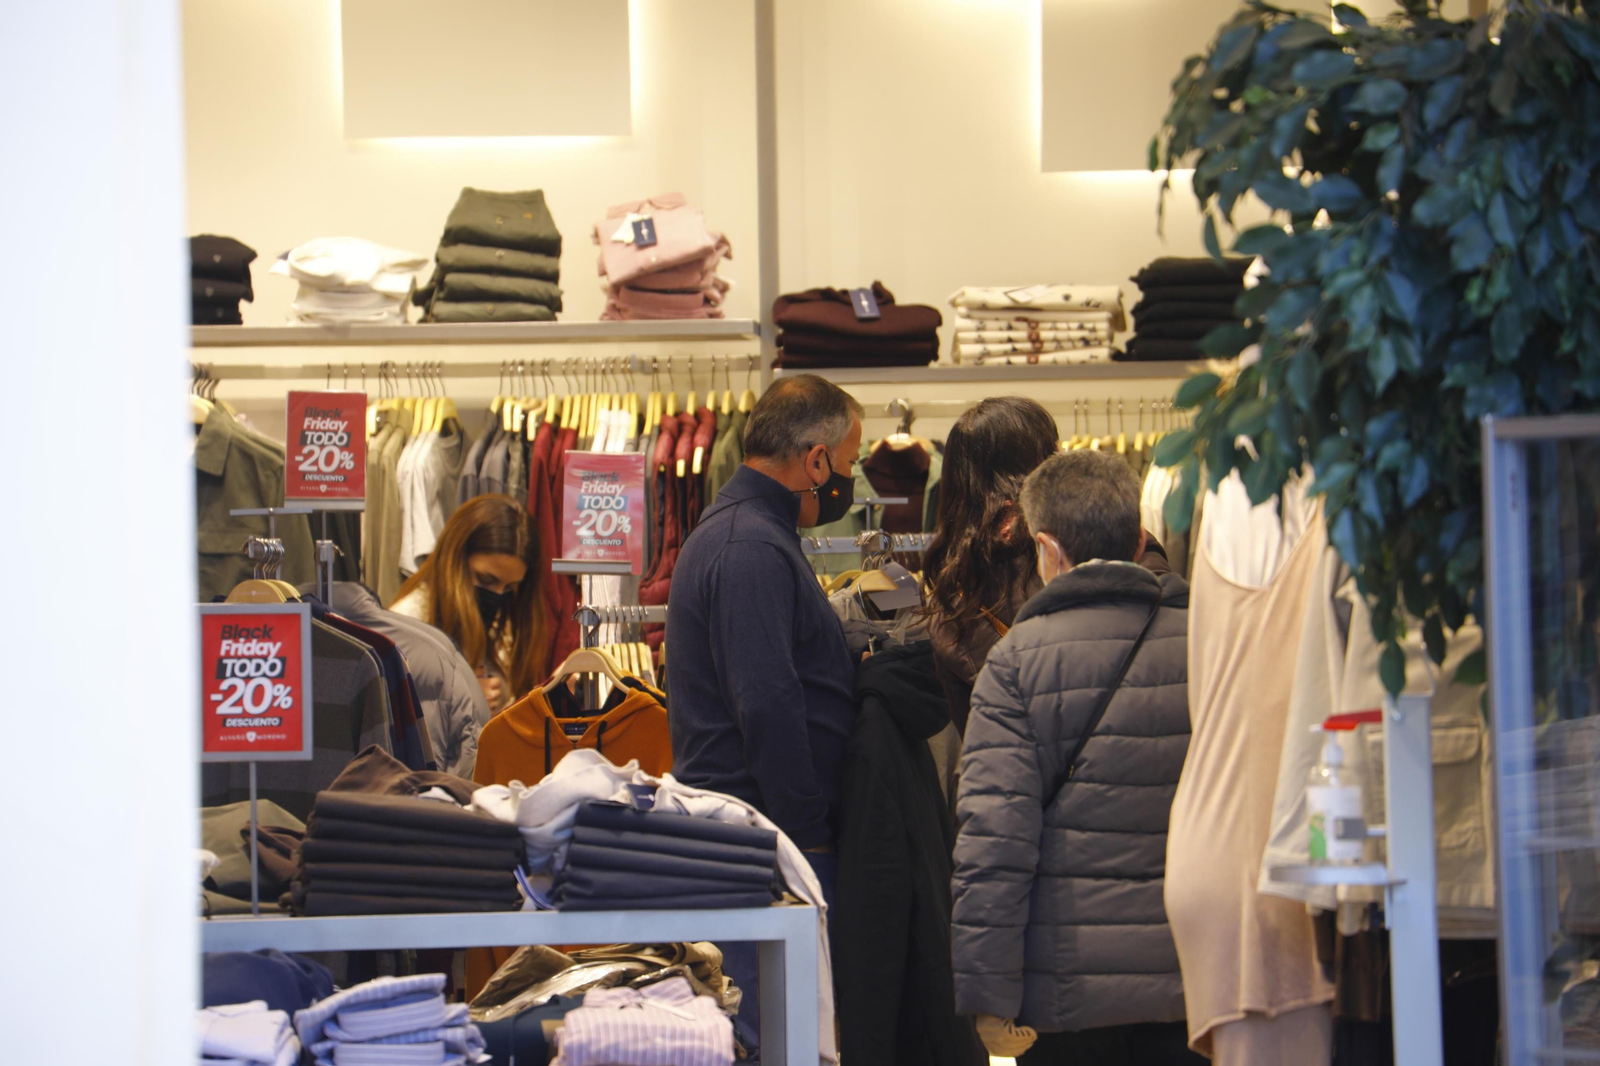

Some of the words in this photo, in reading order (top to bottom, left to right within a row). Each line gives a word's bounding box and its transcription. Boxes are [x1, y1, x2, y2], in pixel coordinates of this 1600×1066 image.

[304, 407, 342, 418] Black
[303, 417, 348, 433] Friday
[305, 431, 348, 446] TODO
[295, 445, 355, 473] -20%
[304, 474, 345, 482] DESCUENTO
[582, 470, 620, 482] Black
[581, 480, 625, 496] Friday
[583, 495, 625, 510] TODO
[572, 509, 632, 537] -20%
[221, 623, 274, 640] Black
[220, 638, 282, 660] Friday
[222, 658, 282, 678] TODO
[210, 677, 293, 715] -20%
[225, 718, 280, 727] DESCUENTO
